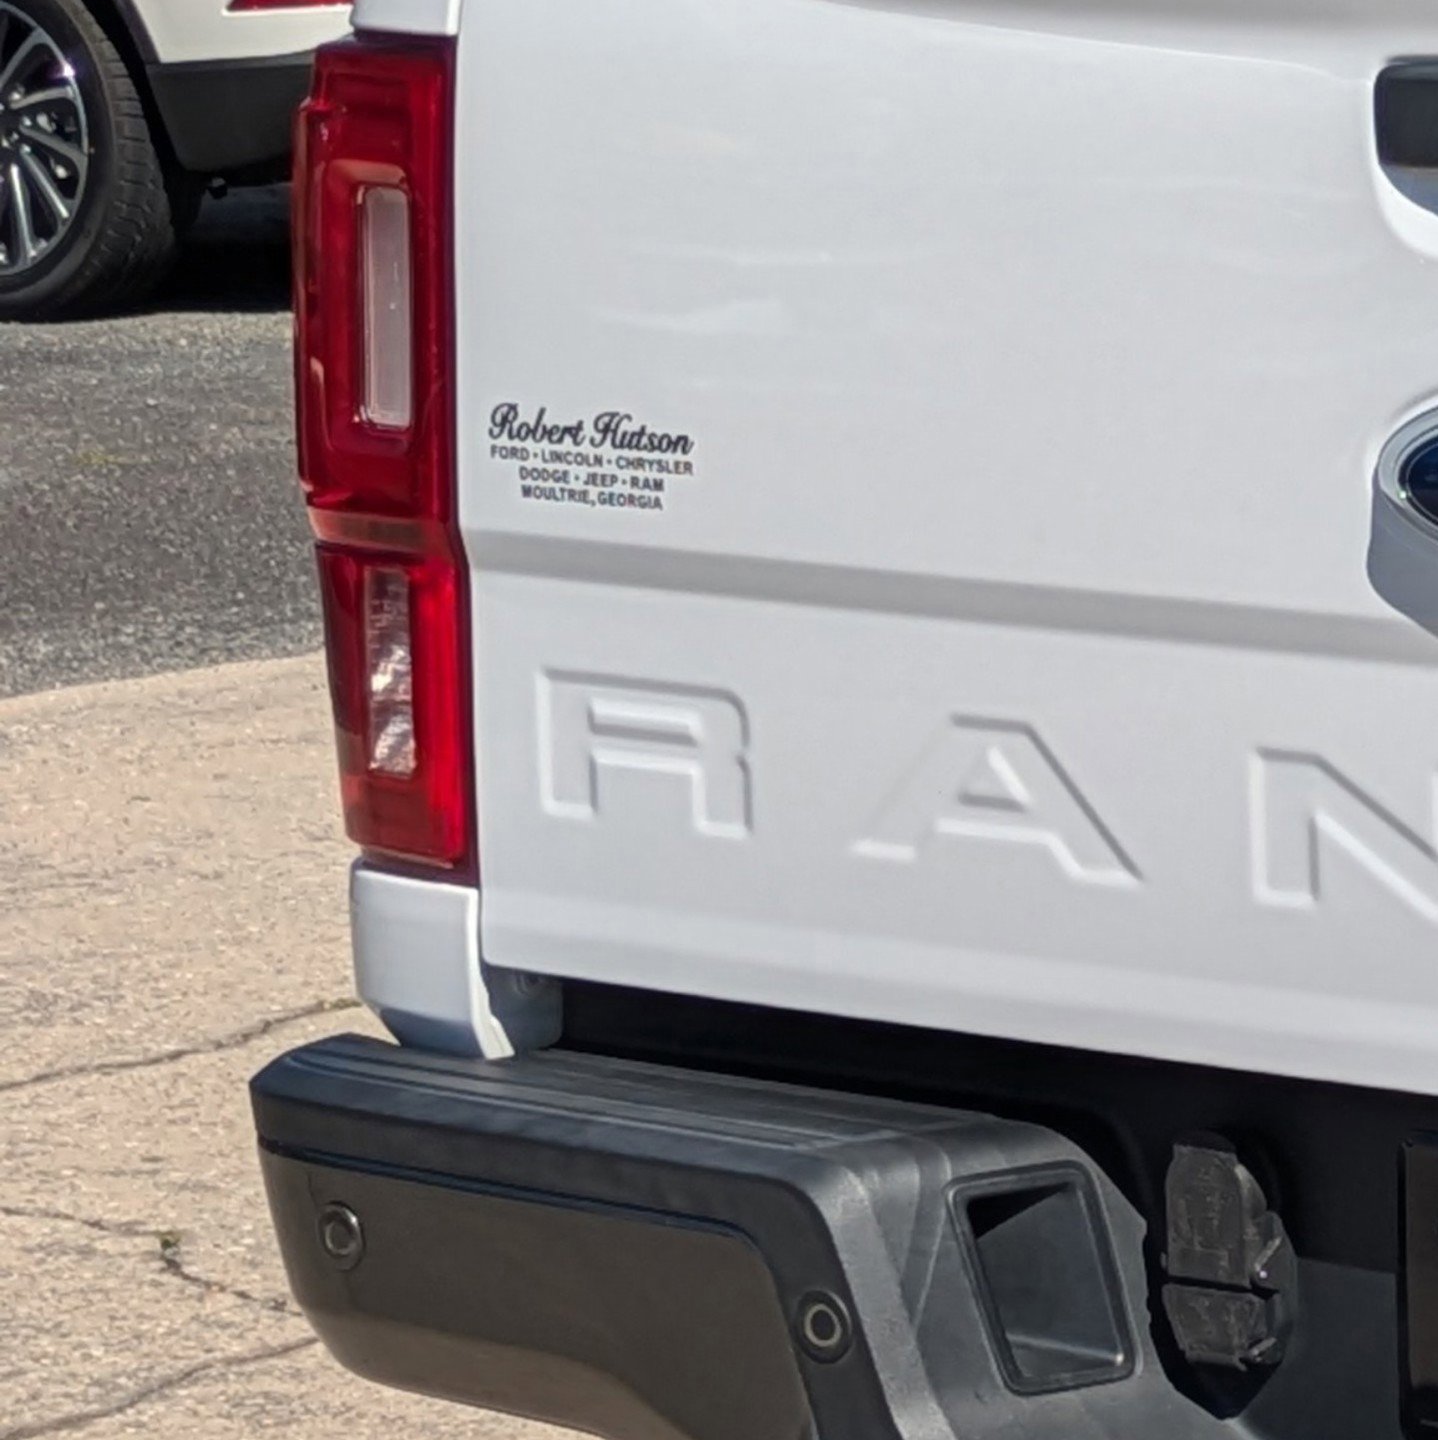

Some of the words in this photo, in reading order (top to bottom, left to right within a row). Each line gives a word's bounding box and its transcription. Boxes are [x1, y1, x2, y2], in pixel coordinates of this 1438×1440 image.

[488, 402, 587, 447] Robert
[589, 411, 695, 455] Hutson
[490, 445, 530, 461] FORD
[541, 449, 604, 467] LINCOLN
[615, 456, 693, 475] CHRYSLER
[518, 466, 571, 484] DODGE
[583, 472, 618, 489] JEEP
[630, 476, 665, 492] RAM
[520, 484, 596, 507] MOULTRIE,
[597, 491, 663, 510] GEORGIA
